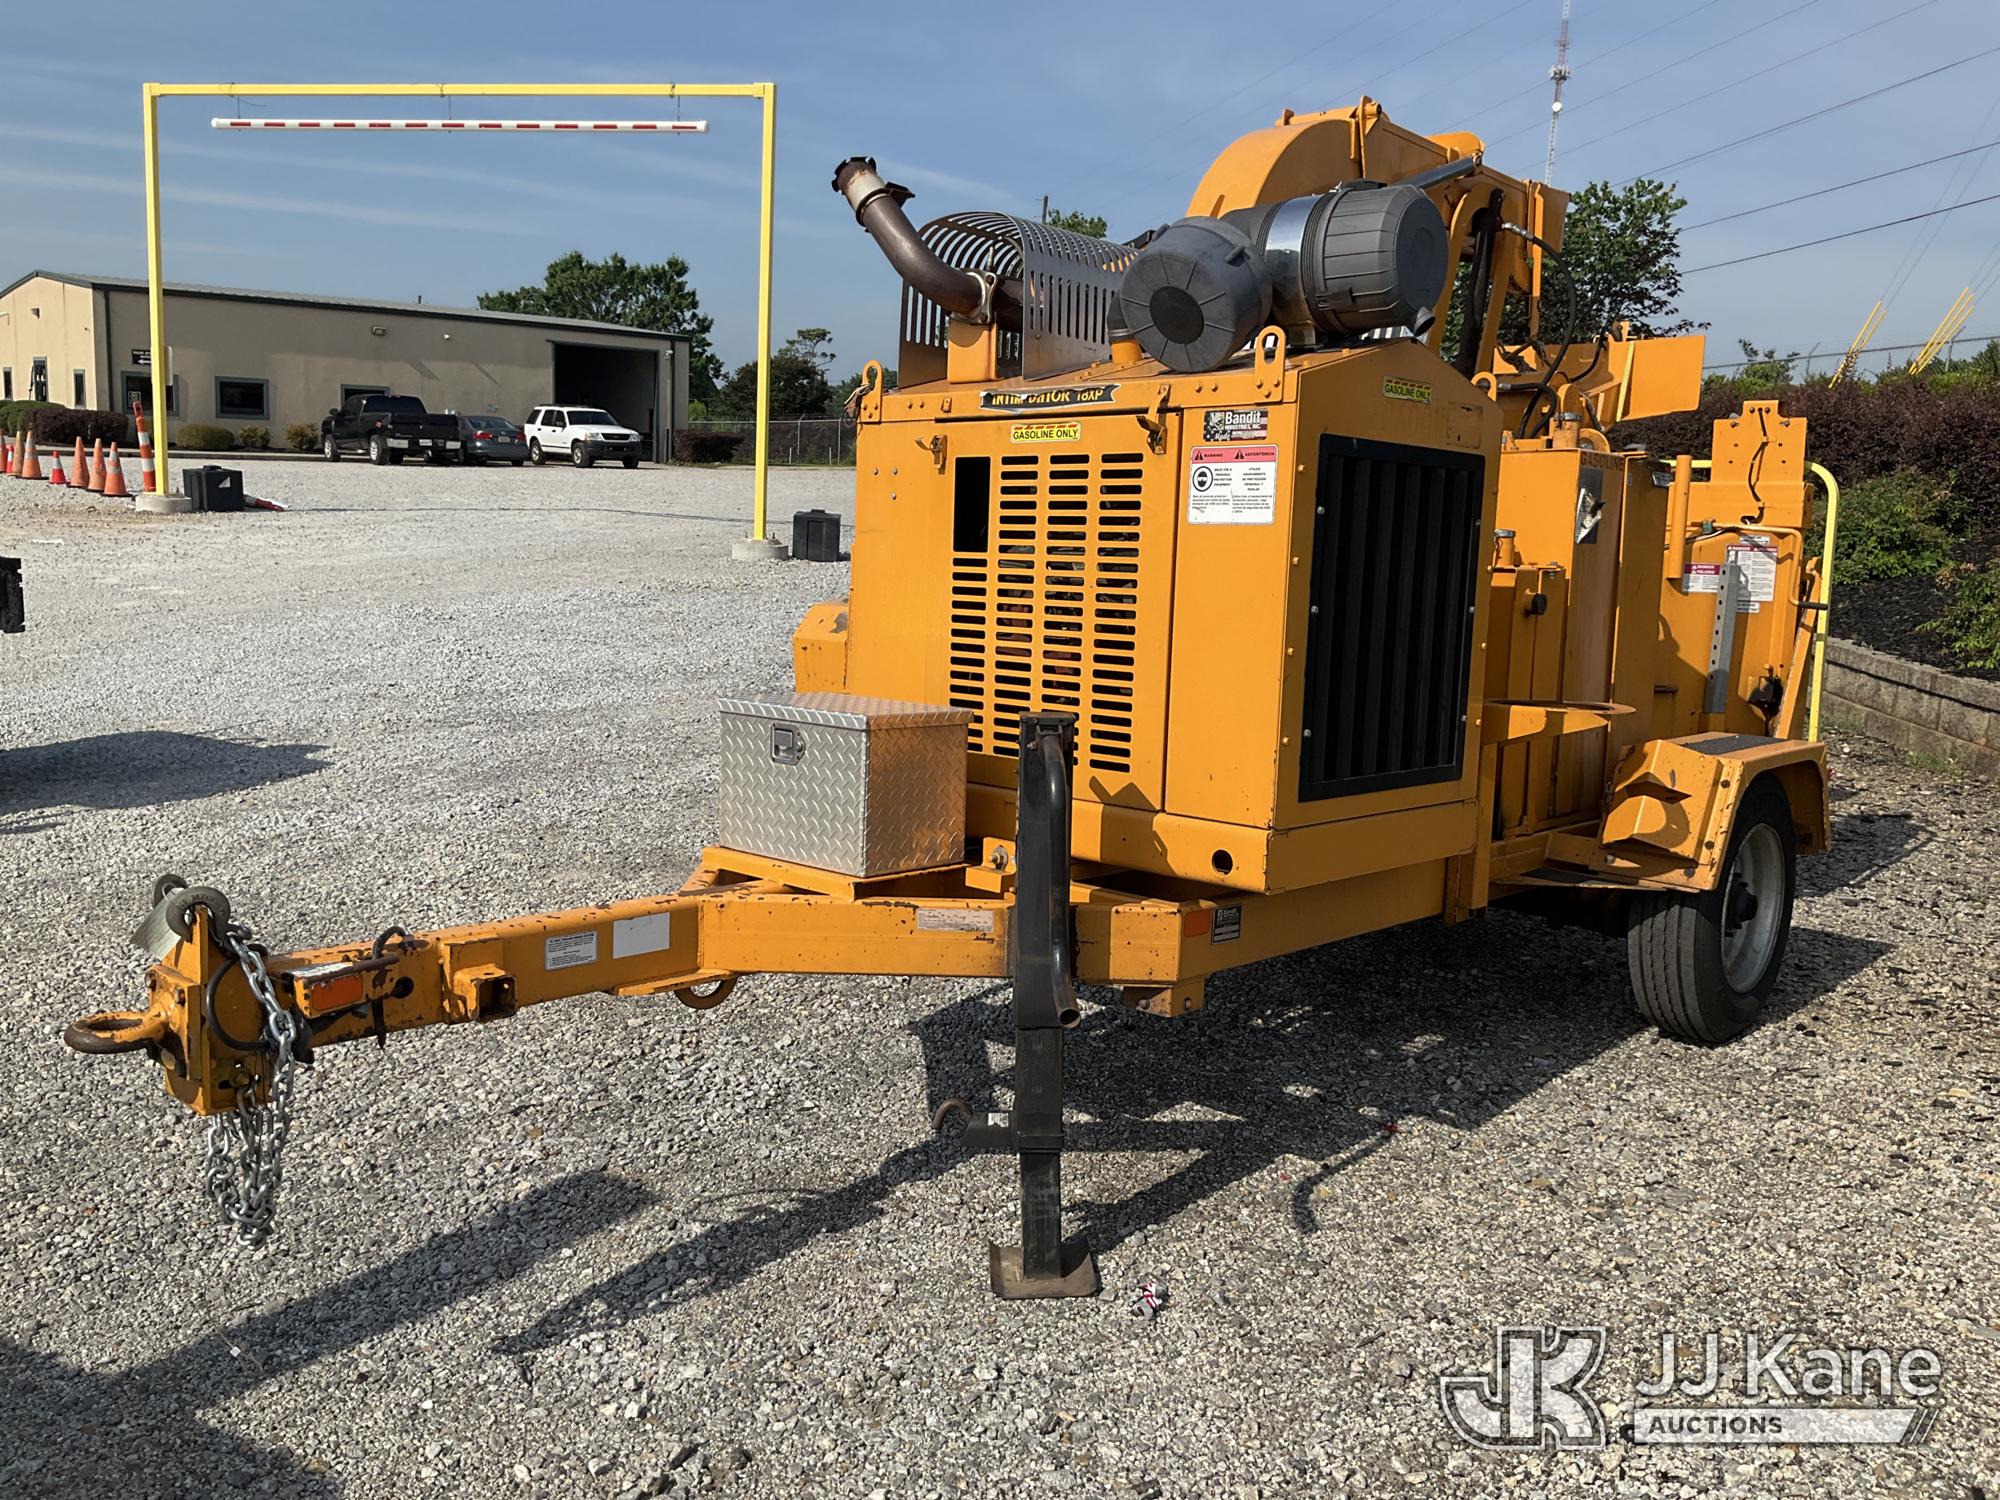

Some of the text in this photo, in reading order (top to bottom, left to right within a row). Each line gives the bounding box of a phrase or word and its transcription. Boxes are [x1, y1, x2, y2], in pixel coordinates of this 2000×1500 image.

[1384, 384, 1431, 400] GASOLINE ONLY
[1225, 410, 1262, 425] Bandit
[1013, 429, 1078, 440] GASOLINE ONLY
[1581, 452, 1625, 472] GASOLINE
